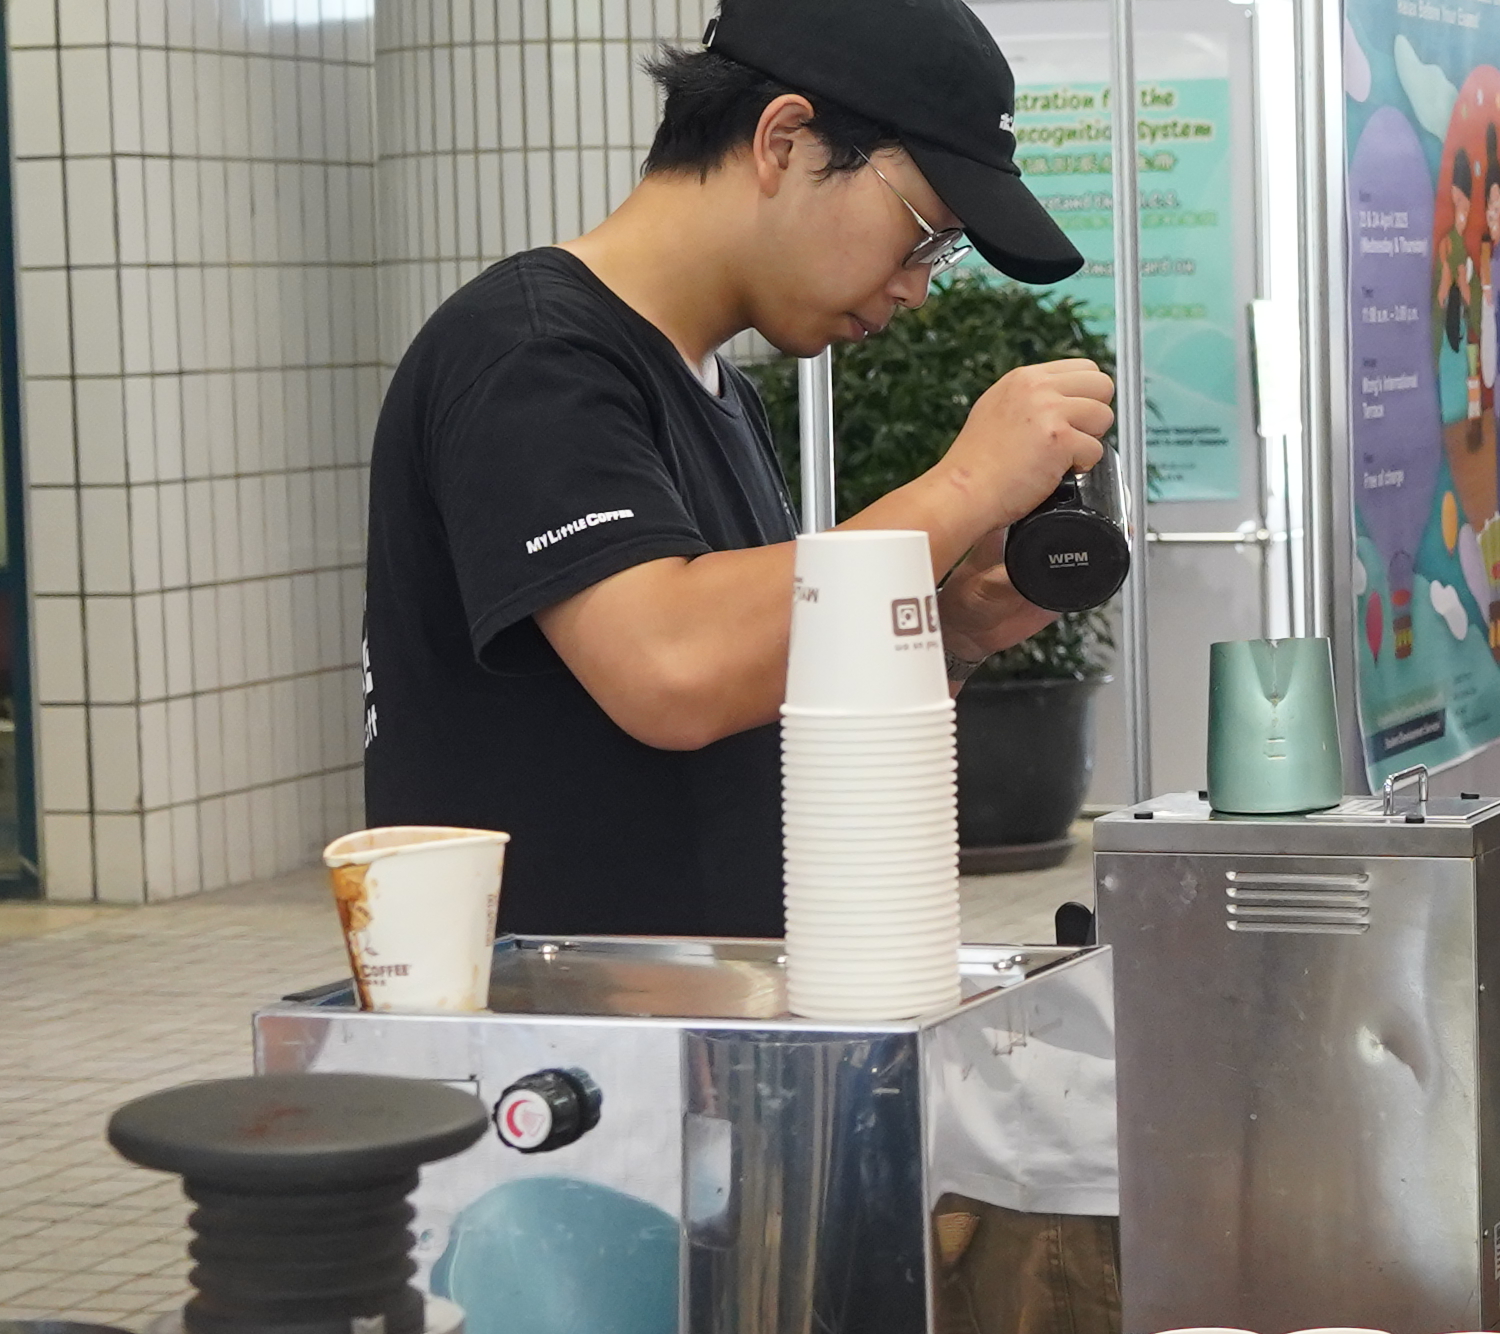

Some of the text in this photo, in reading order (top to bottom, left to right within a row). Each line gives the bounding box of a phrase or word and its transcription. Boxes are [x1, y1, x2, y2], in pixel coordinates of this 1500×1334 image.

[1141, 87, 1175, 108] the
[1016, 121, 1112, 146] ecognitio
[1048, 552, 1088, 564] WPM
